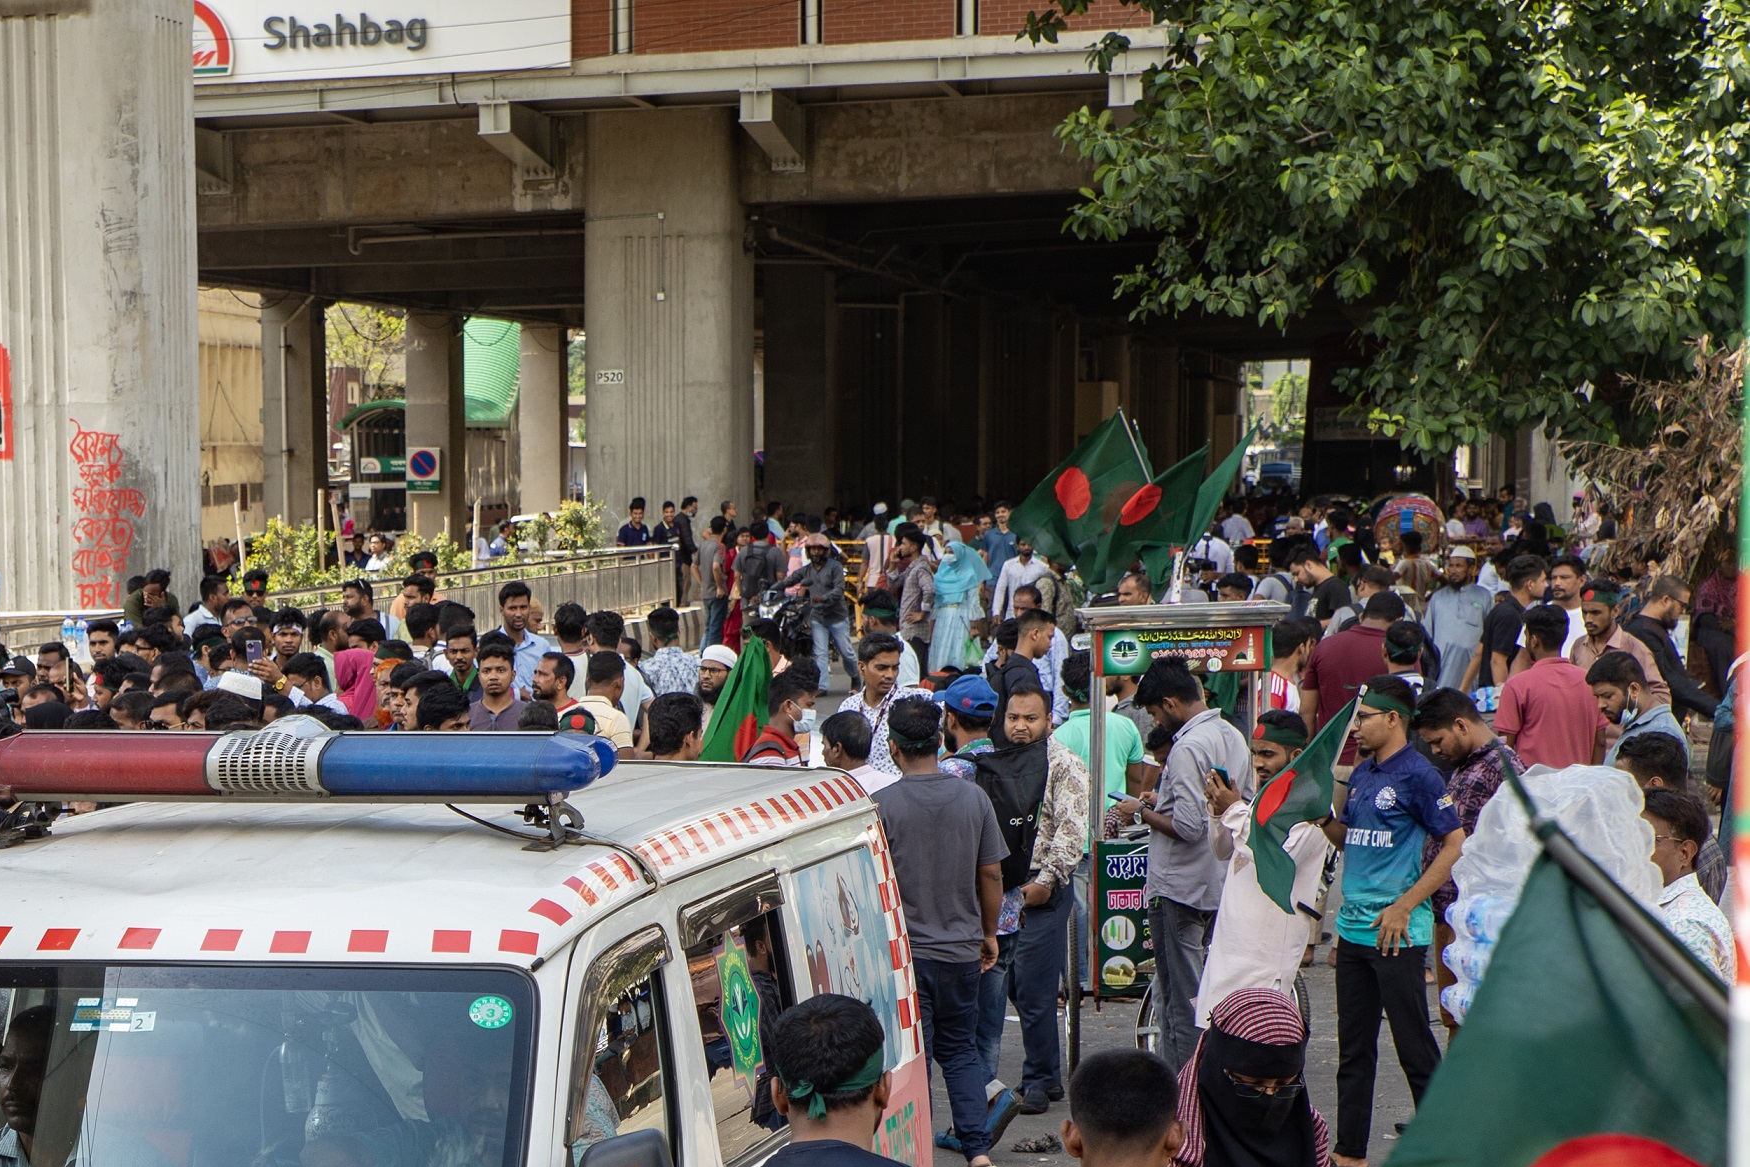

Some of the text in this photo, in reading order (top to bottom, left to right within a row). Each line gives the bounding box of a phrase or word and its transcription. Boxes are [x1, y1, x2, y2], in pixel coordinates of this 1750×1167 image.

[263, 13, 427, 51] Shahbag
[597, 372, 623, 383] P520
[1010, 814, 1033, 827] opo
[1371, 830, 1394, 848] CIVIL
[1107, 889, 1142, 911] ঢাকার
[486, 1008, 495, 1018] 3
